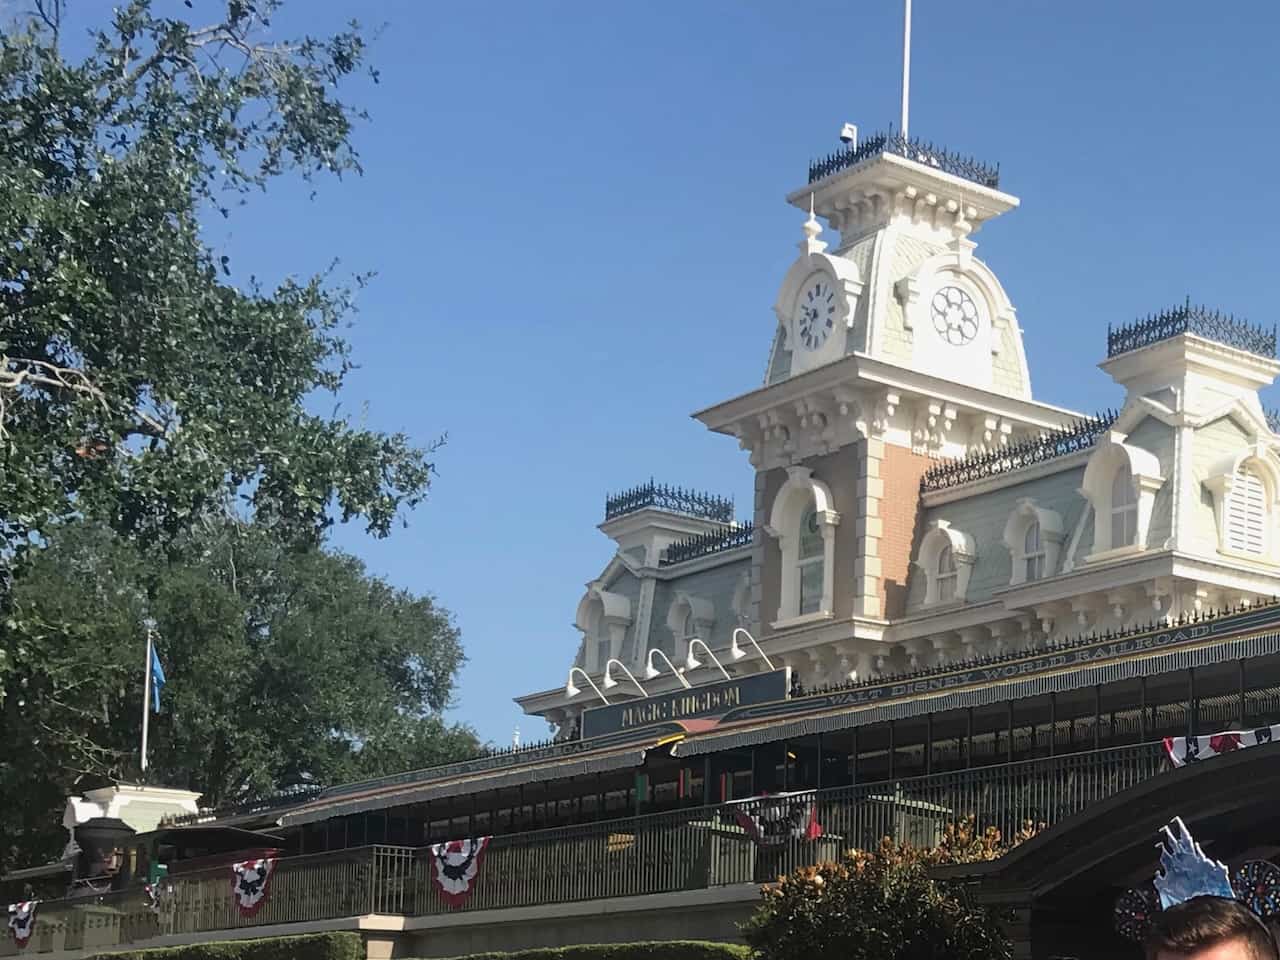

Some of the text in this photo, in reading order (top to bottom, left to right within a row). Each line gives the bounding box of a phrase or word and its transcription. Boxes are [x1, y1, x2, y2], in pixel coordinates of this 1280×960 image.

[983, 654, 1066, 681] WORLD
[1074, 625, 1210, 662] RAILROAD
[621, 686, 741, 727] MAGIC KINGDOM
